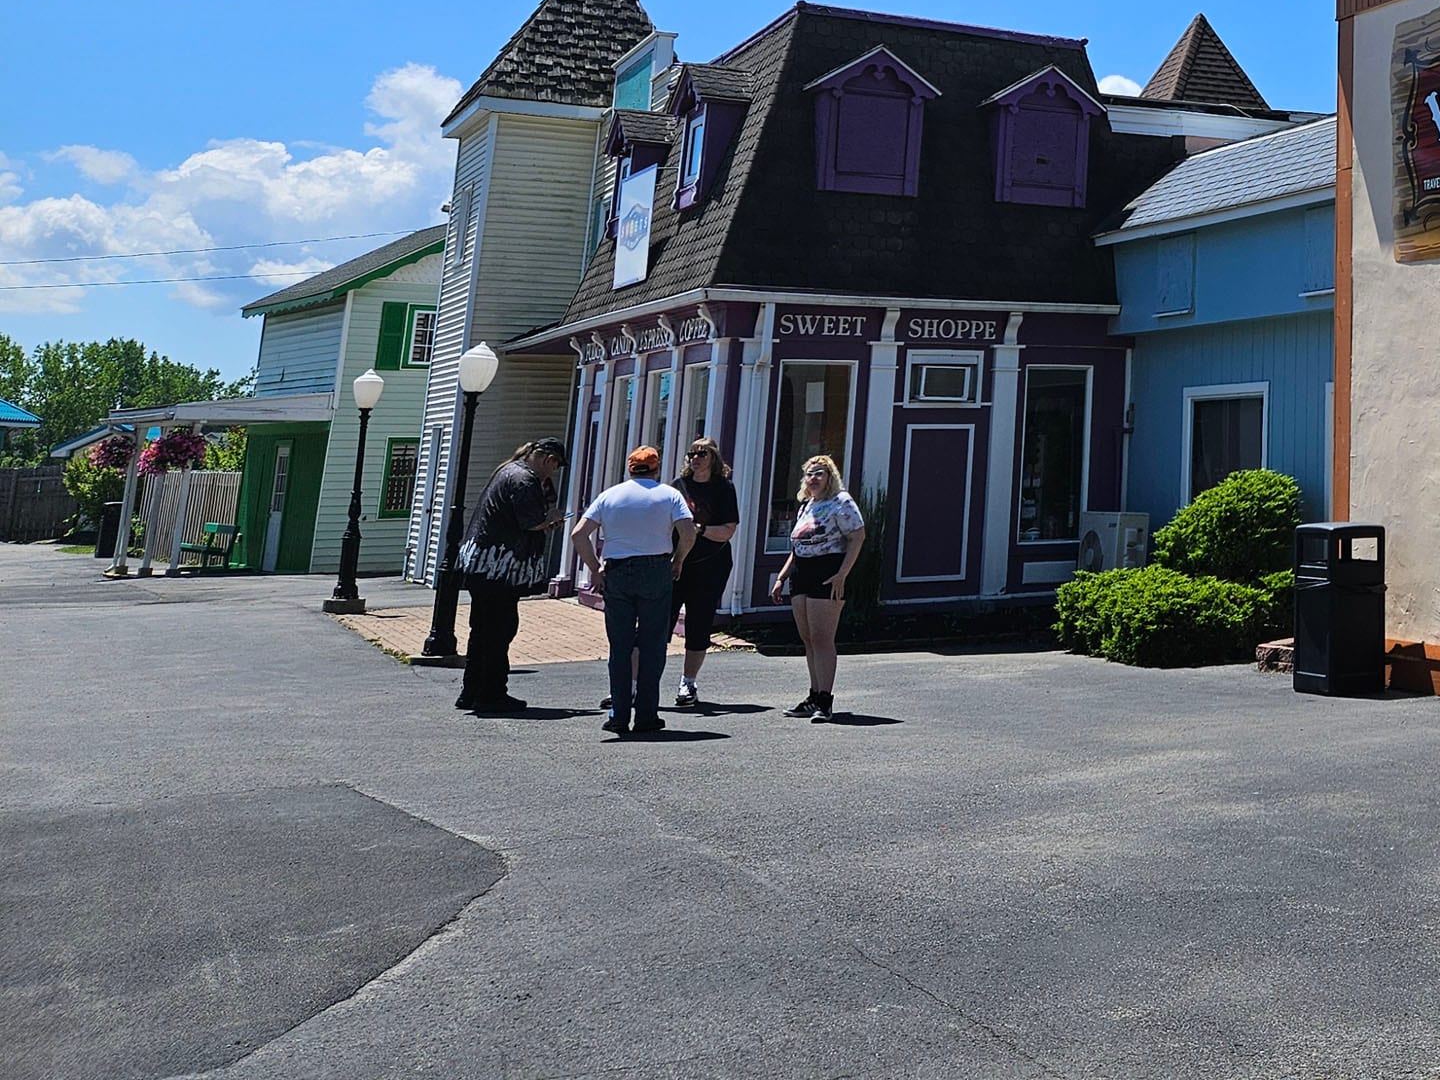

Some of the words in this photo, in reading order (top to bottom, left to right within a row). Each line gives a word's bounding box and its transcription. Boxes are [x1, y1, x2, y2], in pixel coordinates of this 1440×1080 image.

[679, 317, 708, 342] COFFEE
[779, 314, 867, 336] SWEET
[908, 318, 997, 340] SHOPPE
[585, 342, 604, 361] FUDG
